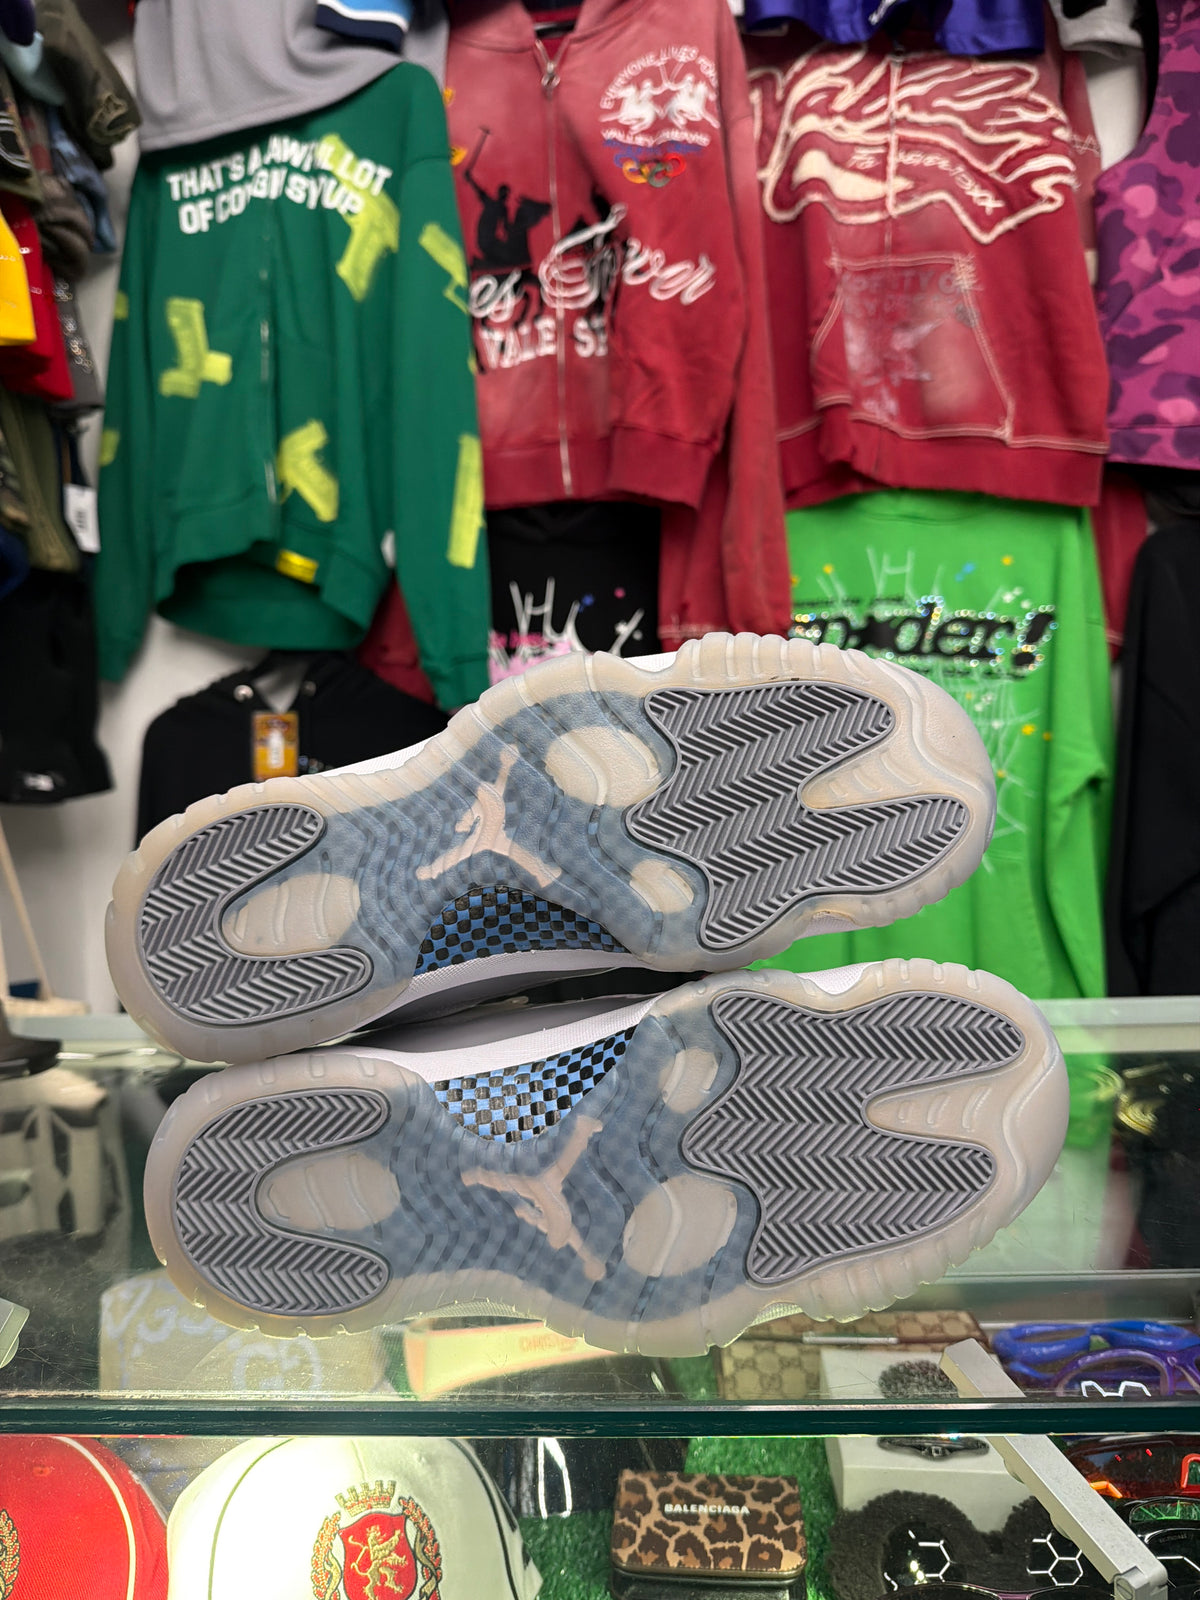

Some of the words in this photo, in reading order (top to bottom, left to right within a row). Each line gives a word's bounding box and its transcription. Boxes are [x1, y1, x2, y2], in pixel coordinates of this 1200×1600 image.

[166, 152, 246, 201] THAT'S
[263, 134, 335, 174] AWL
[335, 150, 393, 197] LOT
[178, 198, 214, 235] OF
[284, 173, 366, 217] SYUP
[664, 1503, 750, 1515] BALENCIAGA
